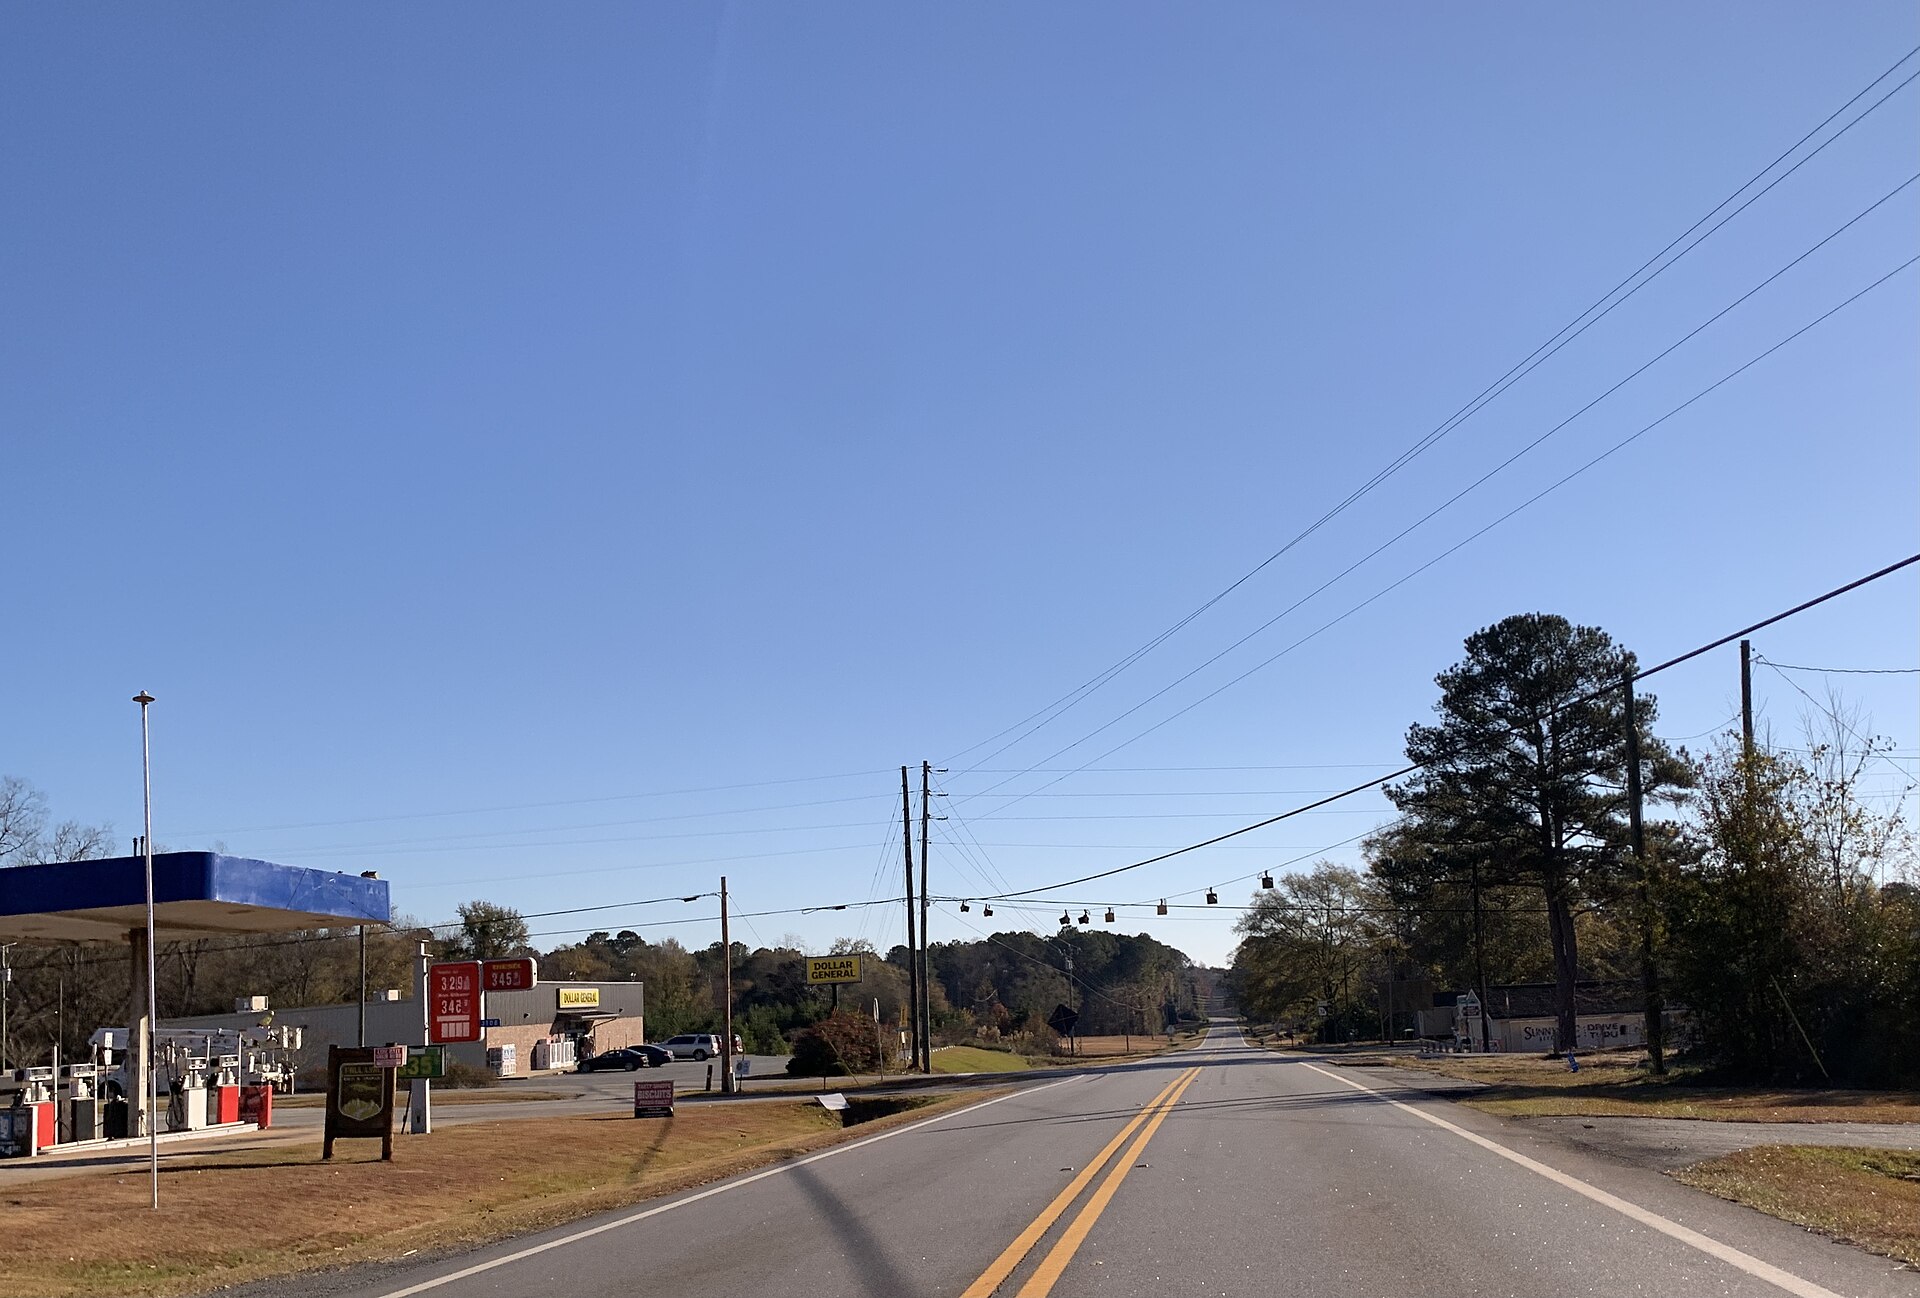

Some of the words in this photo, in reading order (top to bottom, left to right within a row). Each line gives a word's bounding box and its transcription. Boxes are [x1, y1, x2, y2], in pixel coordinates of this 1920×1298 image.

[813, 961, 852, 970] DOLLAR
[811, 970, 856, 979] GENERAL
[1587, 1023, 1618, 1031] DRIVE
[637, 1090, 672, 1100] BISCUITS
